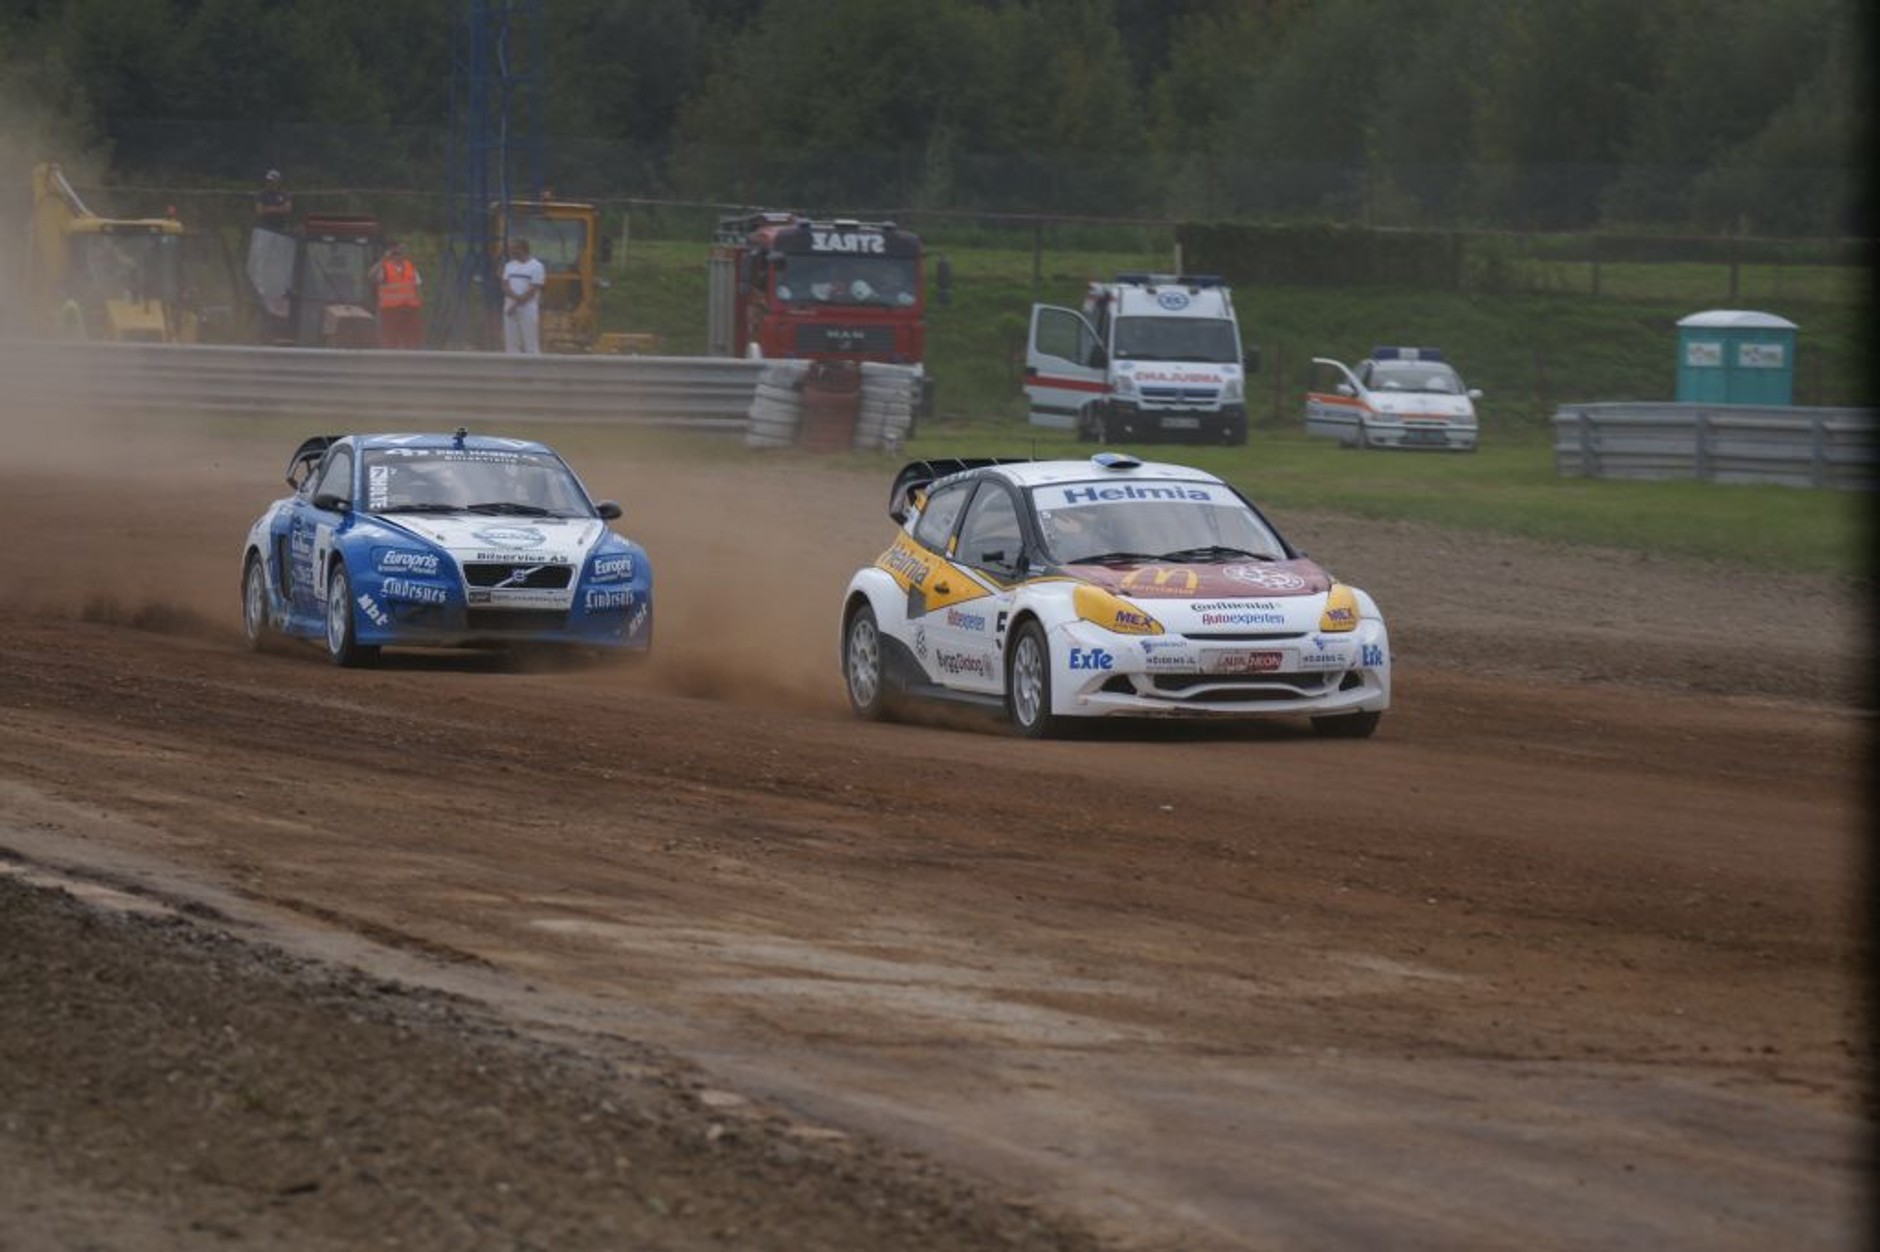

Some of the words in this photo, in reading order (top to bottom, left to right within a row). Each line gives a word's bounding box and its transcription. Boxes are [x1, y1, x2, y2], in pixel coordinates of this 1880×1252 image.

[1063, 485, 1212, 504] Helmia
[383, 550, 441, 568] Europris
[1202, 613, 1285, 626] Autoexperten
[1069, 648, 1114, 670] ExTe
